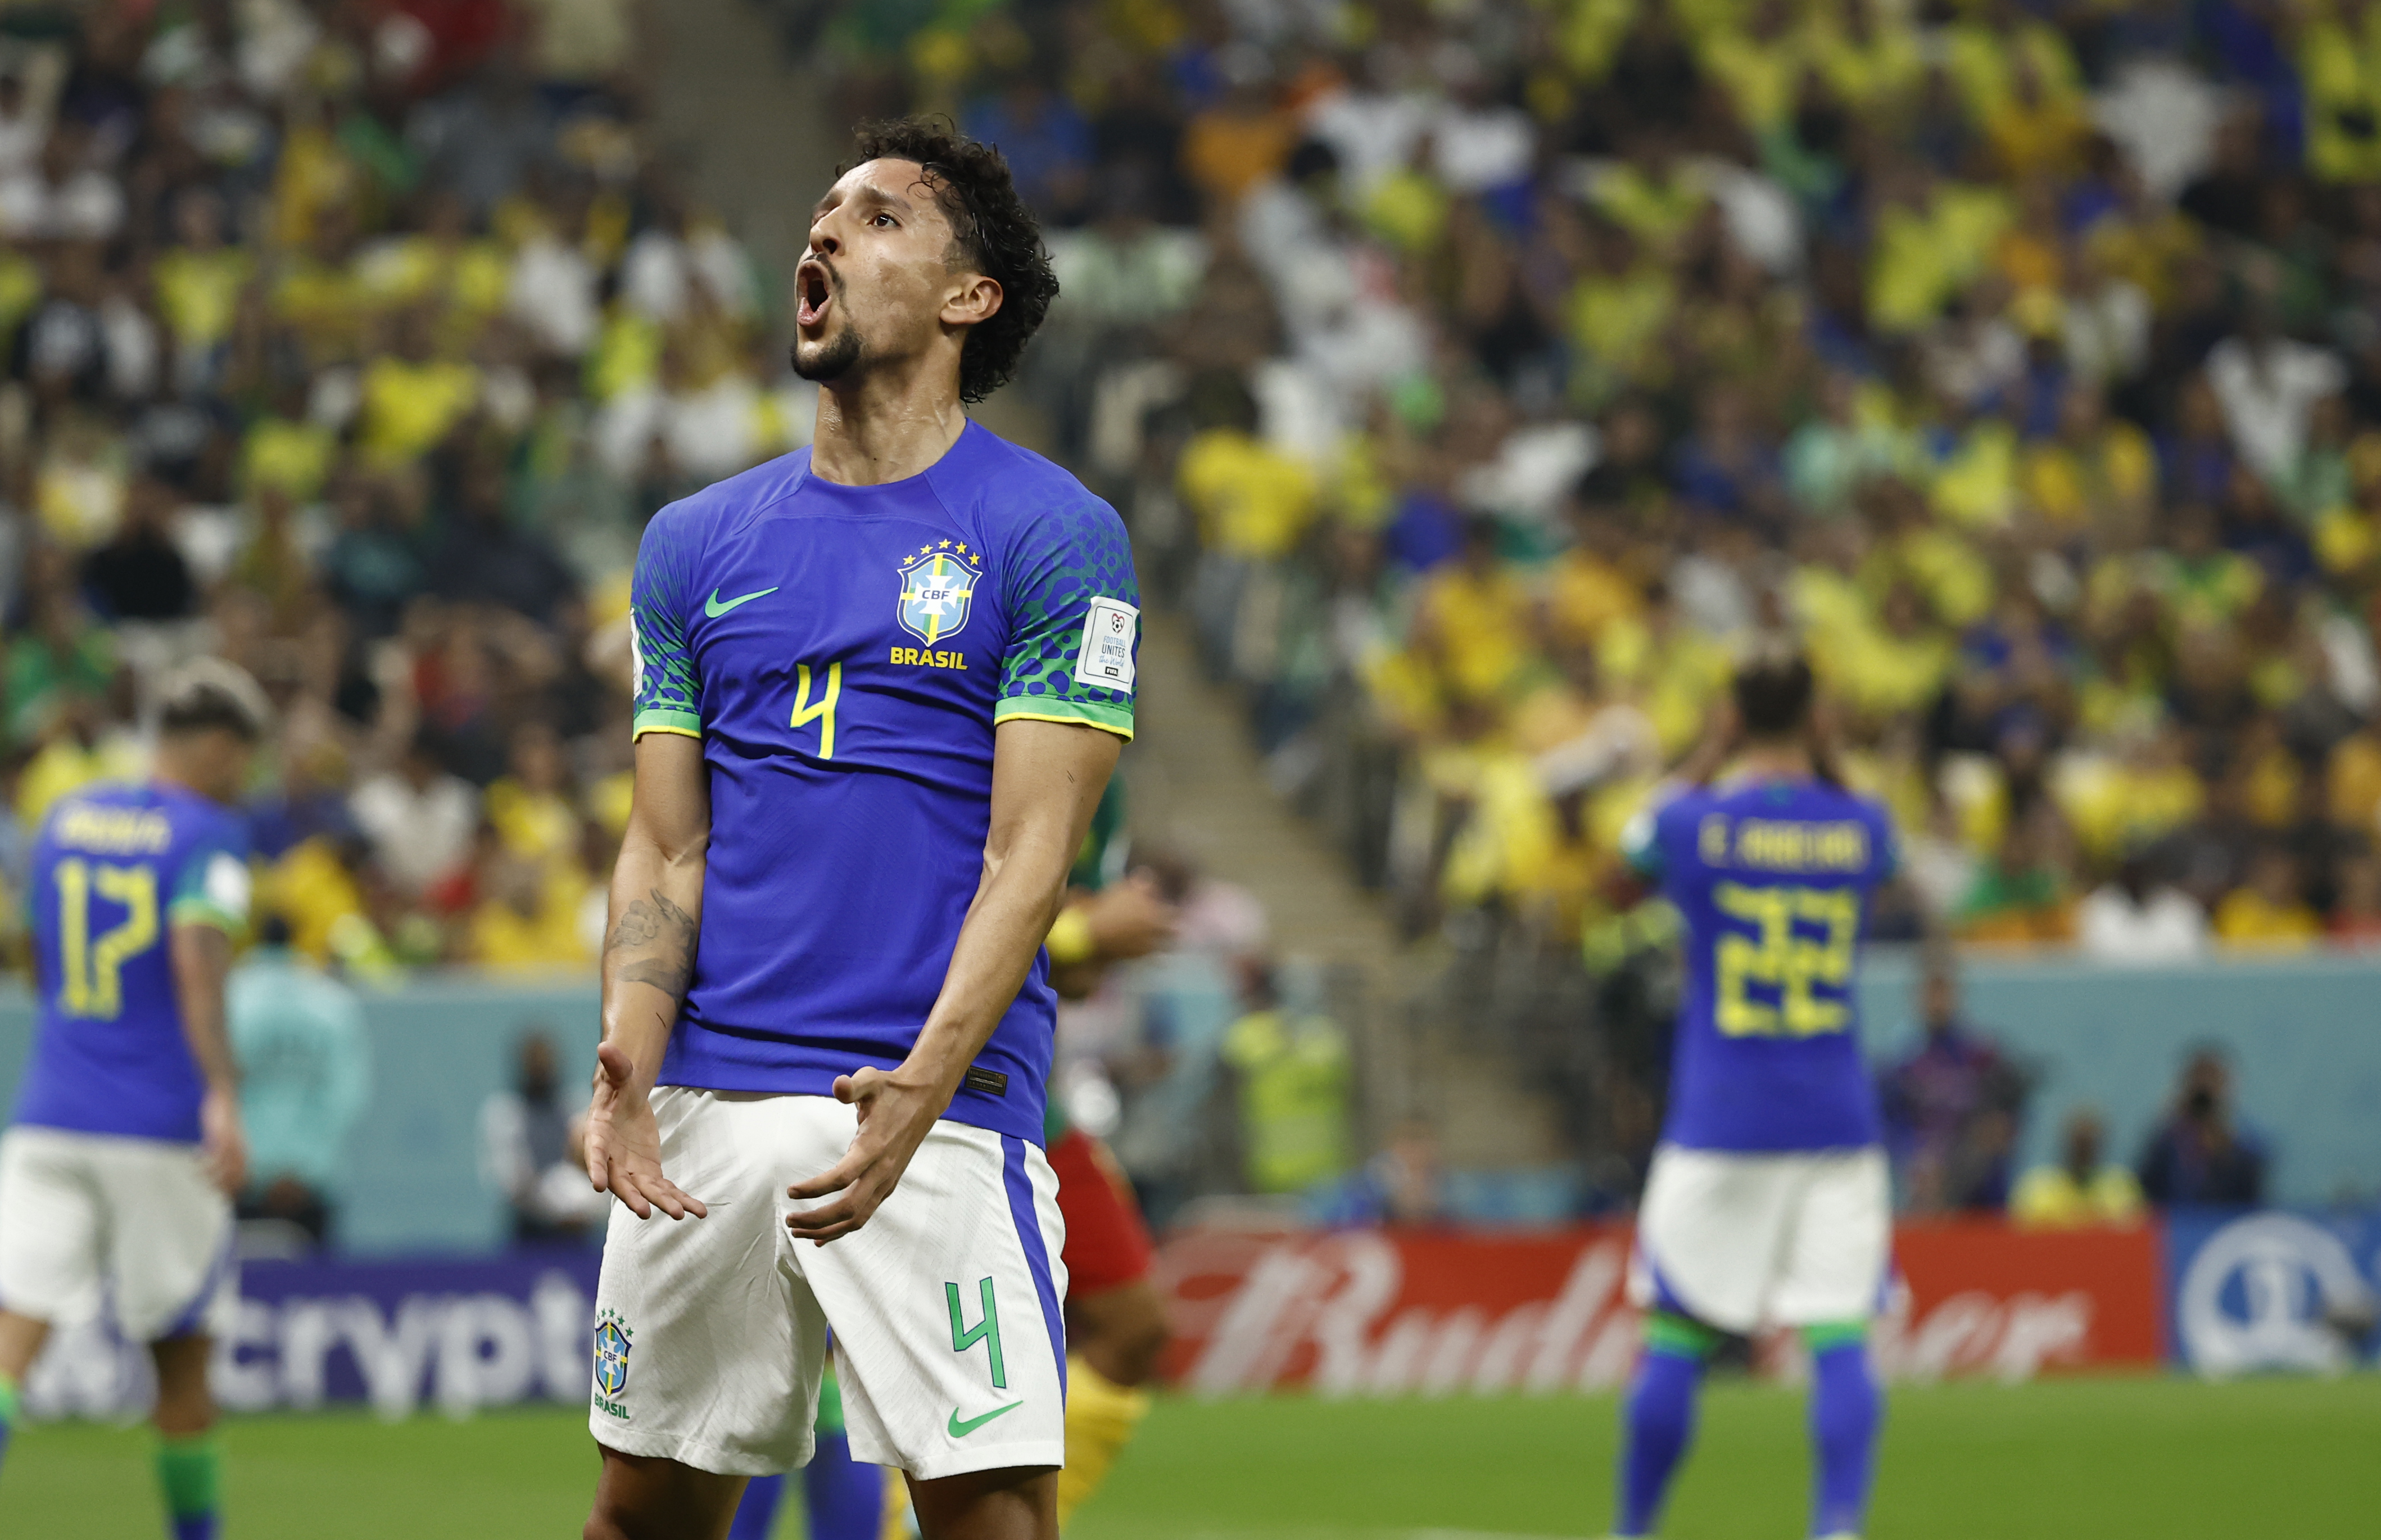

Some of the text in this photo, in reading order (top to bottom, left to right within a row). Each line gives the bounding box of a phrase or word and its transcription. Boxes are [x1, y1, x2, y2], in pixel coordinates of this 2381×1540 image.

[921, 590, 950, 600] CBF
[1102, 644, 1125, 658] UNITES
[1104, 636, 1125, 647] FOOTBALL
[890, 646, 968, 671] BRASIL
[790, 661, 843, 760] 4
[57, 857, 158, 1021] 17
[1713, 881, 1858, 1040] 22
[944, 1275, 1007, 1389] 4
[604, 1350, 618, 1362] CBF
[594, 1392, 631, 1420] BRASIL
